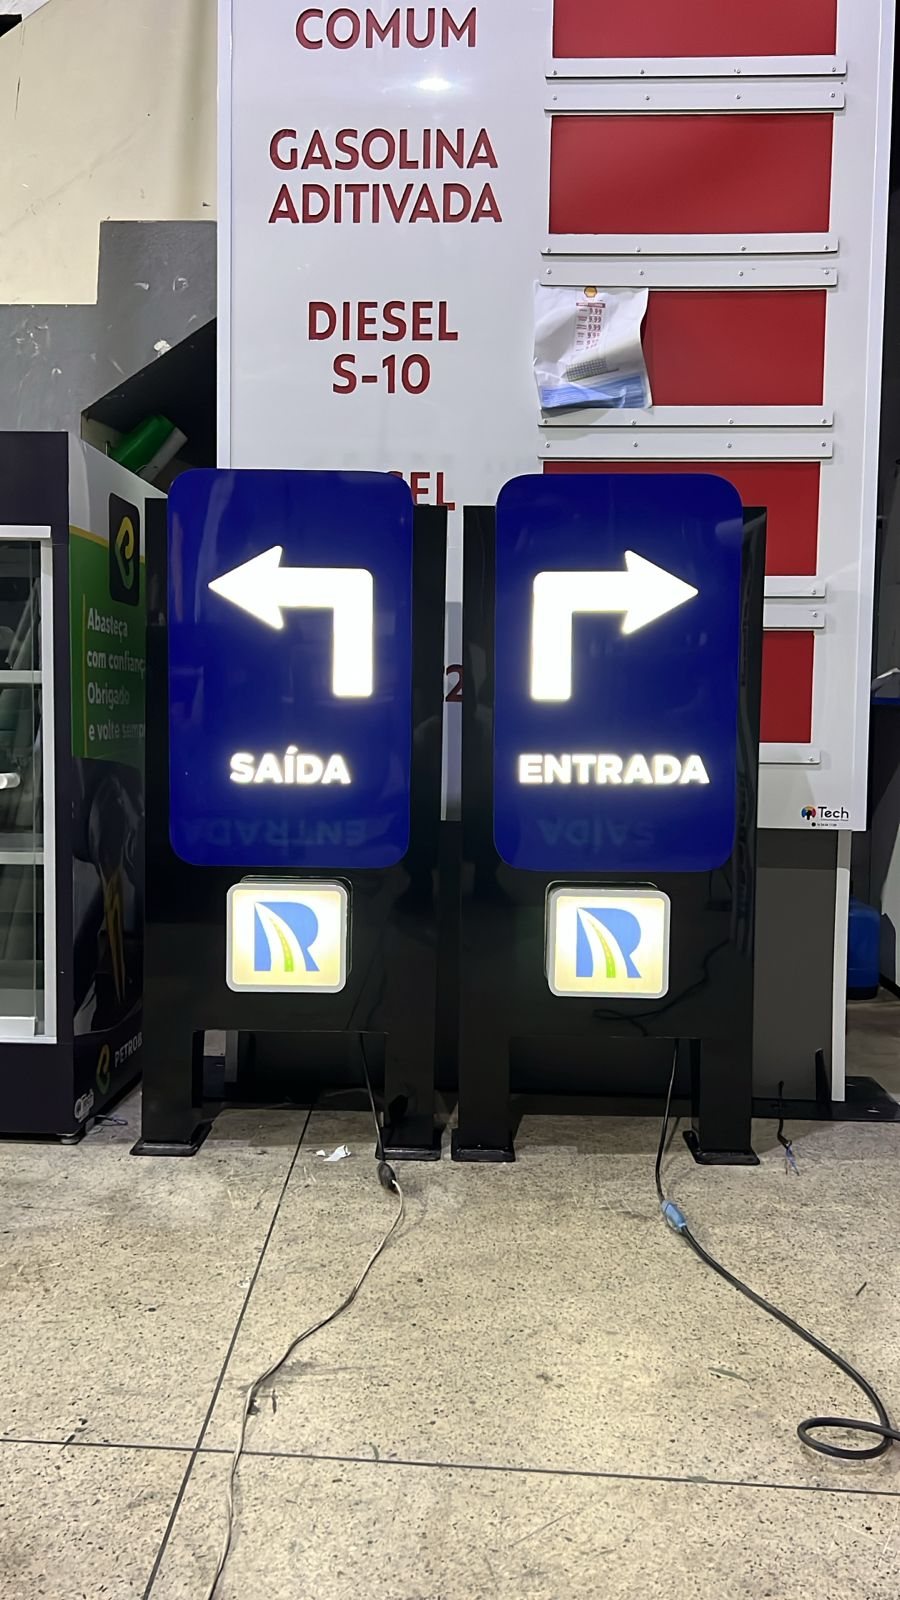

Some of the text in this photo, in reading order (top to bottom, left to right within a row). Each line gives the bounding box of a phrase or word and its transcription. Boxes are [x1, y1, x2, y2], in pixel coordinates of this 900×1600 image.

[296, 7, 477, 49] COMUM
[269, 128, 498, 170] GASOLINA
[268, 183, 502, 224] ADITIVADA
[308, 301, 458, 341] DIESEL
[333, 353, 431, 394] S-10
[387, 470, 455, 511] EL
[88, 608, 129, 643] Abasteça
[87, 650, 109, 669] com
[88, 682, 130, 710] Obrigado
[88, 723, 95, 741] e
[97, 719, 120, 740] volte
[229, 745, 351, 785] SAÍDA
[518, 753, 710, 785] ENTRADA
[817, 806, 849, 819] Tech
